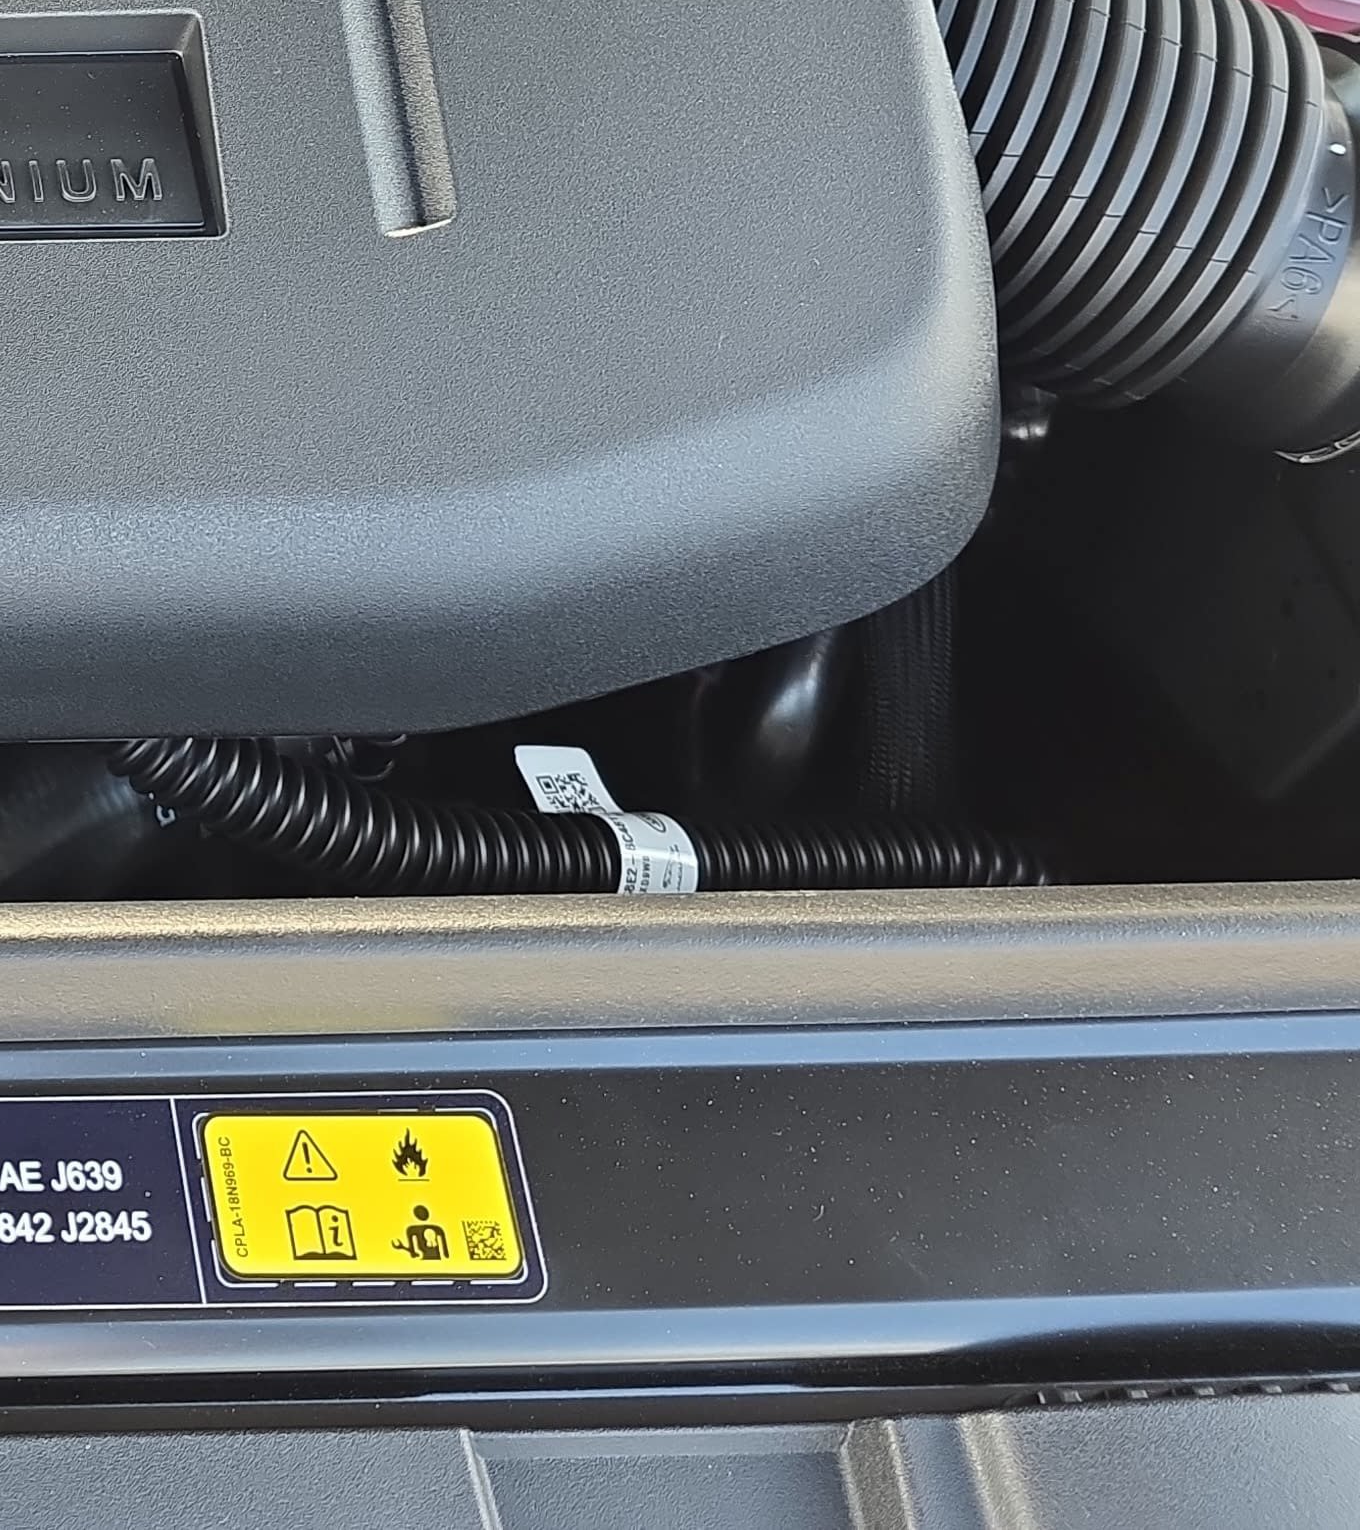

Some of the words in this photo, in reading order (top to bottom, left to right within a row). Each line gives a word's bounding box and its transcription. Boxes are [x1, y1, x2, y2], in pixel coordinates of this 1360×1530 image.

[50, 1160, 123, 1192] J639
[218, 1136, 249, 1258] CPLA-18N969-BC
[60, 1210, 152, 1243] J2845
